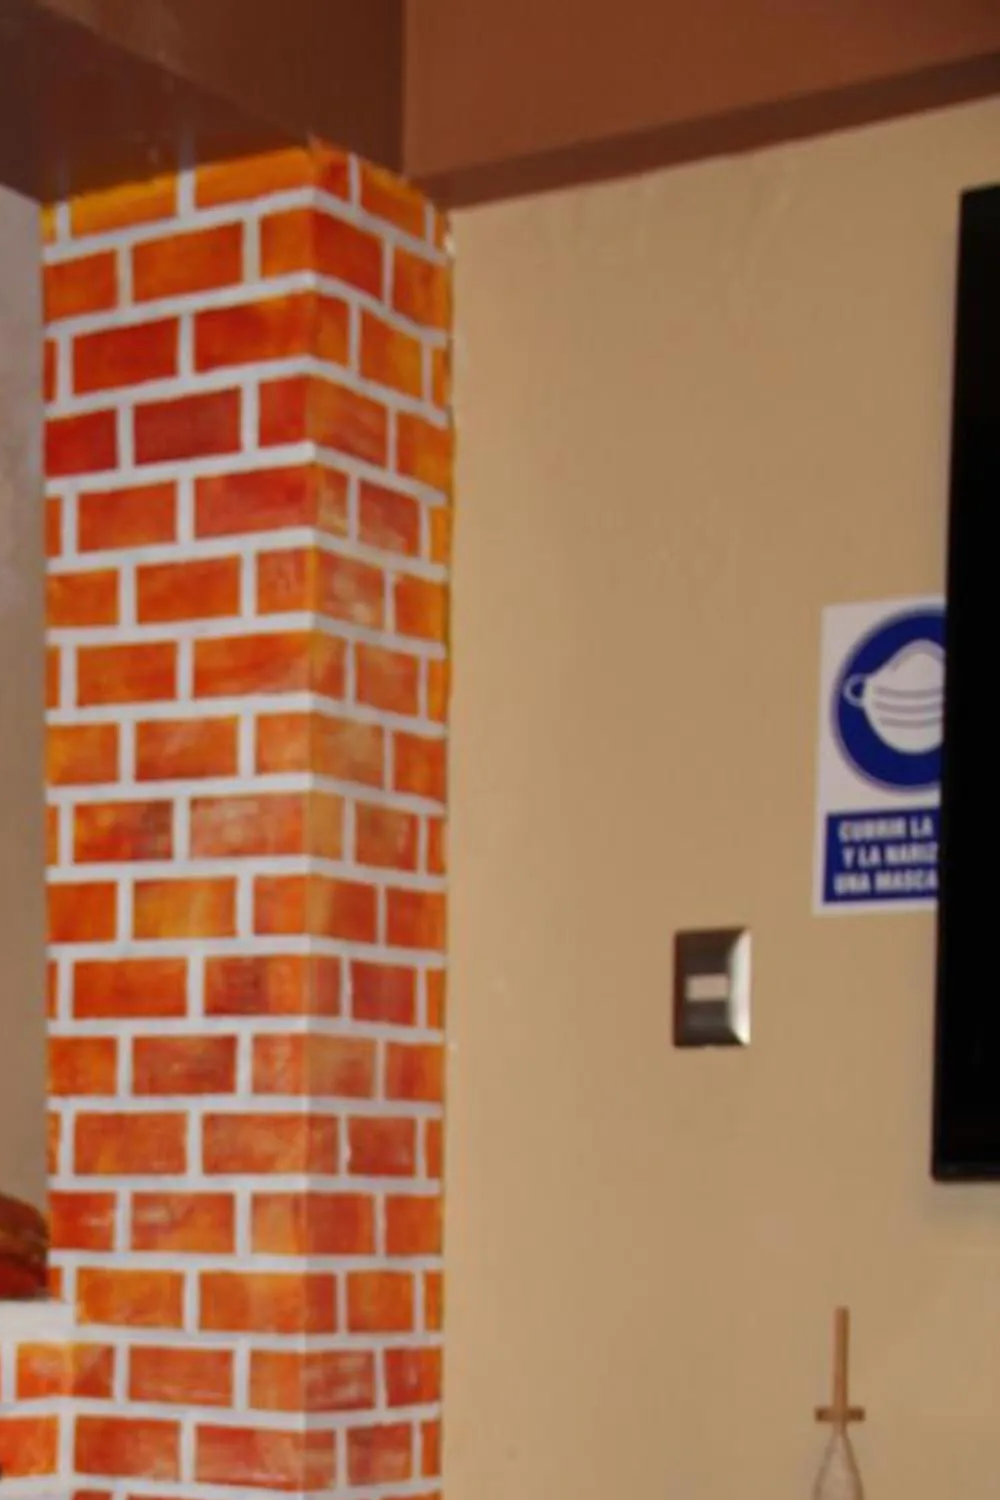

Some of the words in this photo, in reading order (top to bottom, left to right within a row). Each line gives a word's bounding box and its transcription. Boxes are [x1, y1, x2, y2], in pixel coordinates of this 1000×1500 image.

[910, 816, 934, 838] LA
[843, 847, 854, 868] Y
[857, 846, 881, 867] LA
[834, 873, 871, 893] UNA
